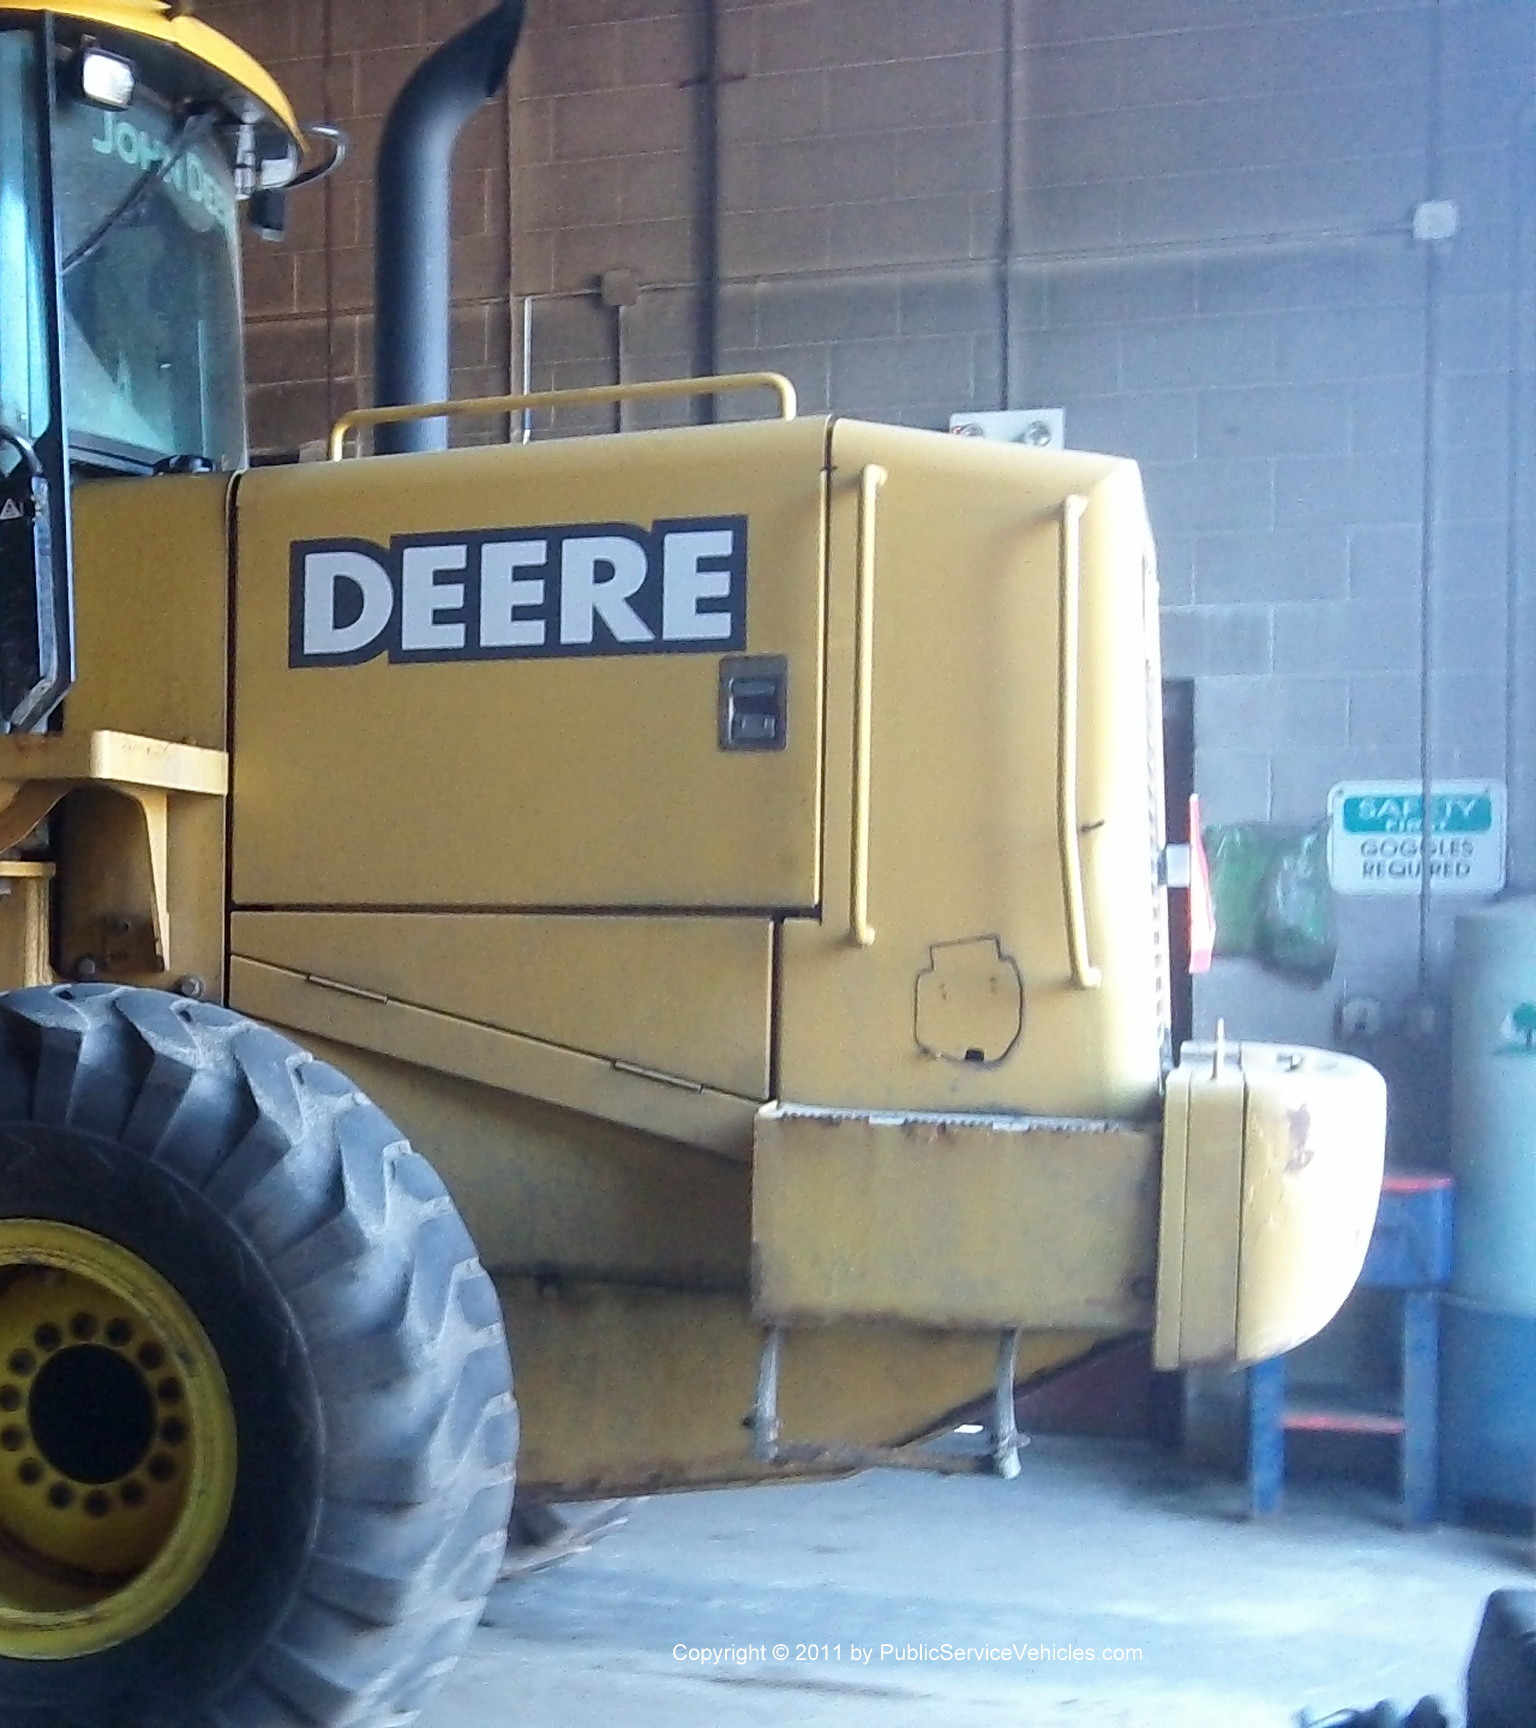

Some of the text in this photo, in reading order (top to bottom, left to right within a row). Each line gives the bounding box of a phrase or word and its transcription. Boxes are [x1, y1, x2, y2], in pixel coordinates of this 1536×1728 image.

[303, 529, 733, 655] DEERE
[1359, 798, 1477, 820] SAFTY
[1363, 860, 1471, 878] REQURED
